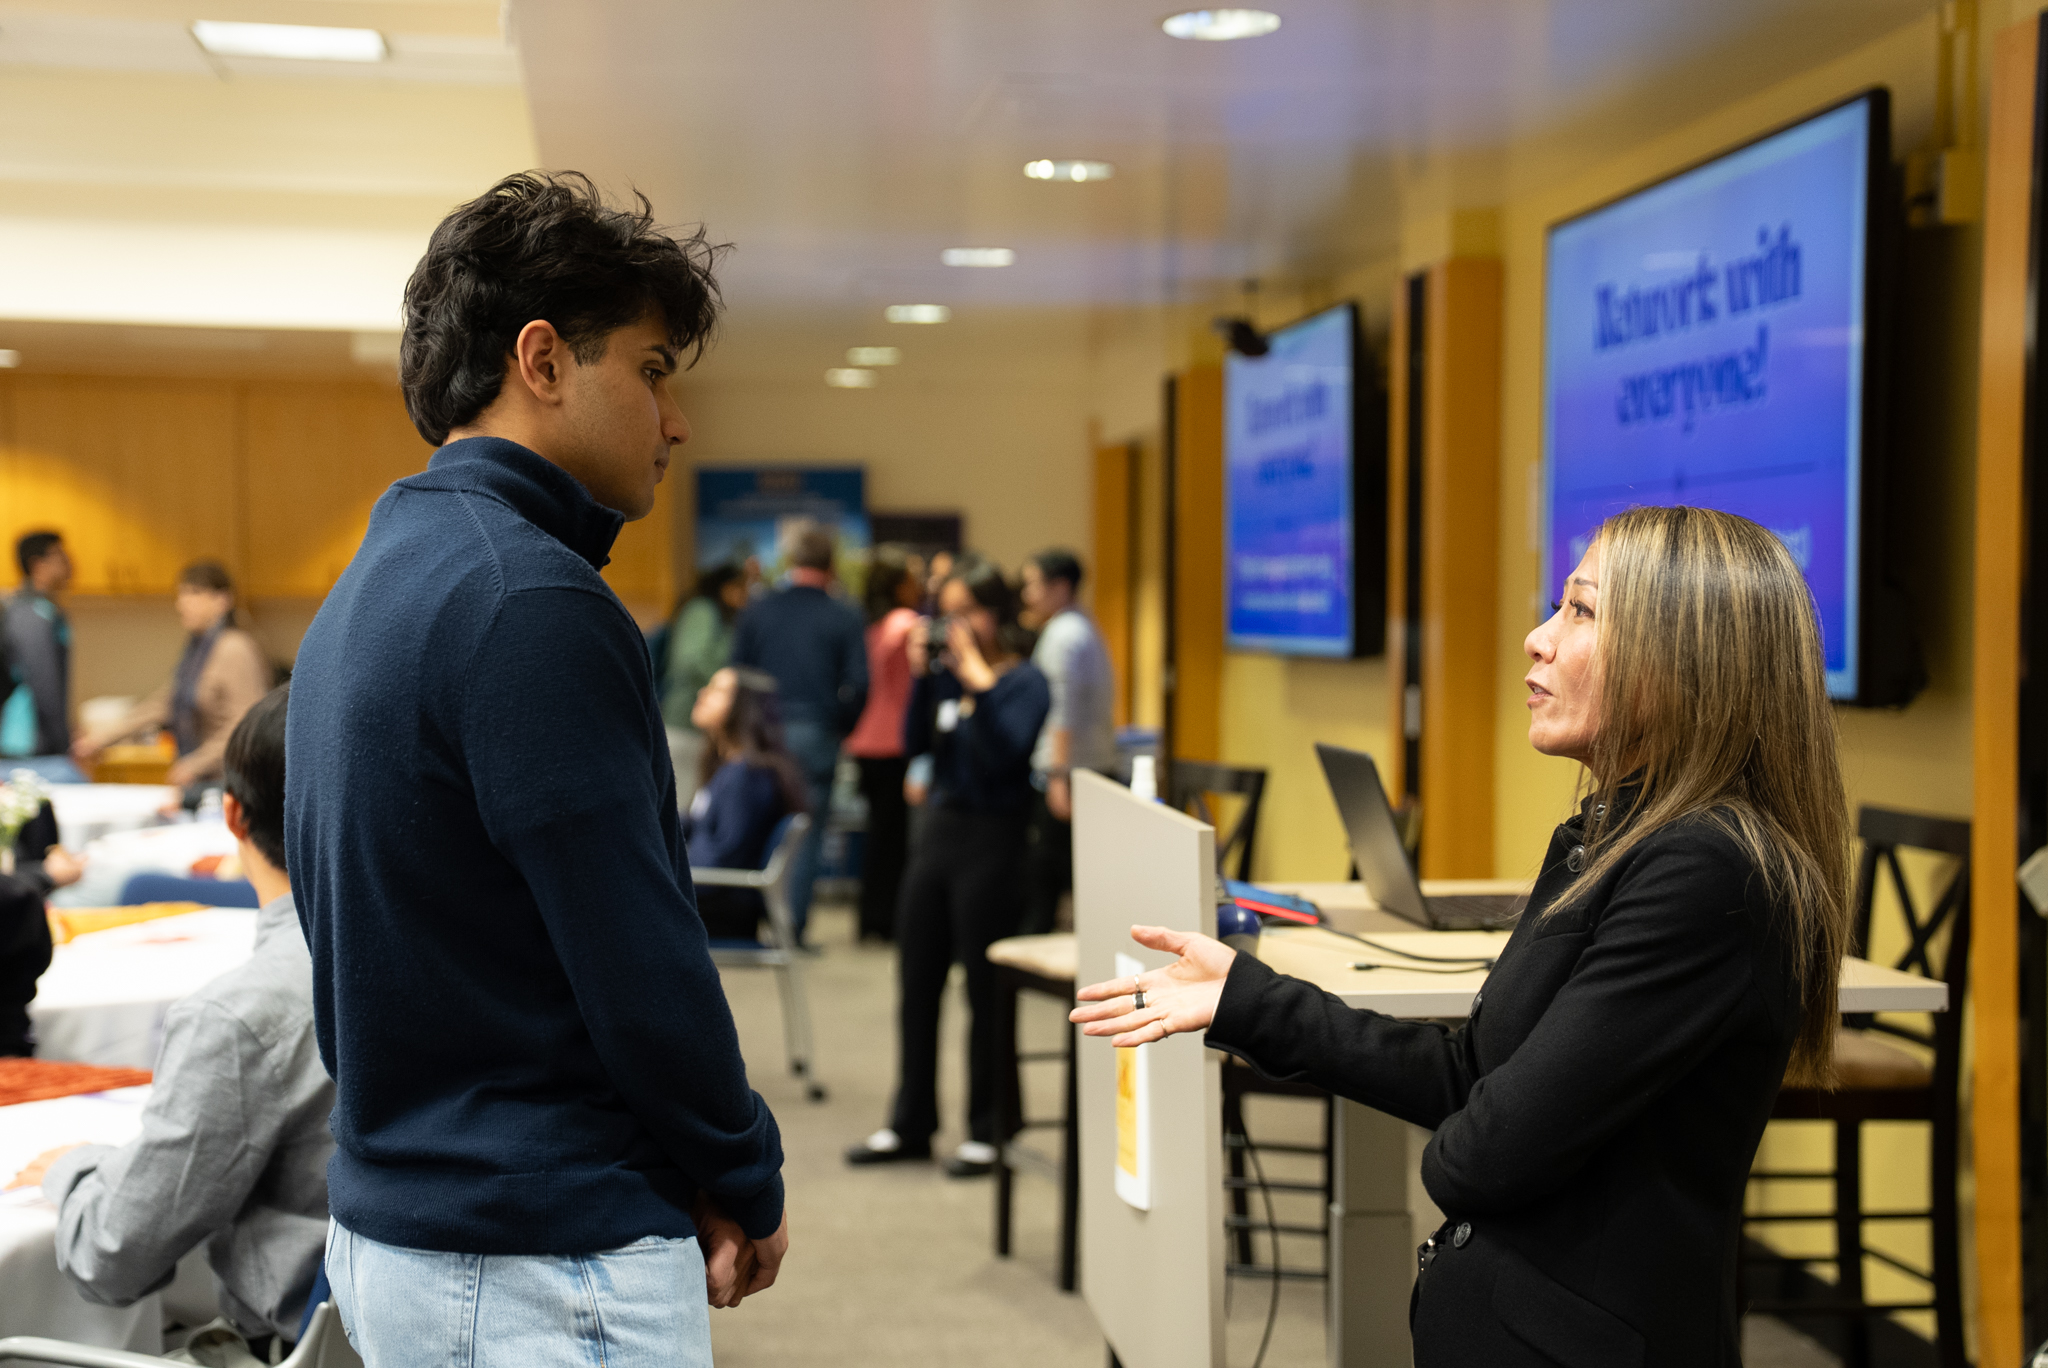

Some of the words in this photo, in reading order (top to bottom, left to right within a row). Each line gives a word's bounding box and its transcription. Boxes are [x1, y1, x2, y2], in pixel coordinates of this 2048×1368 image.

[1595, 249, 1718, 350] Network
[1725, 222, 1803, 313] with
[1616, 324, 1768, 433] everyone!
